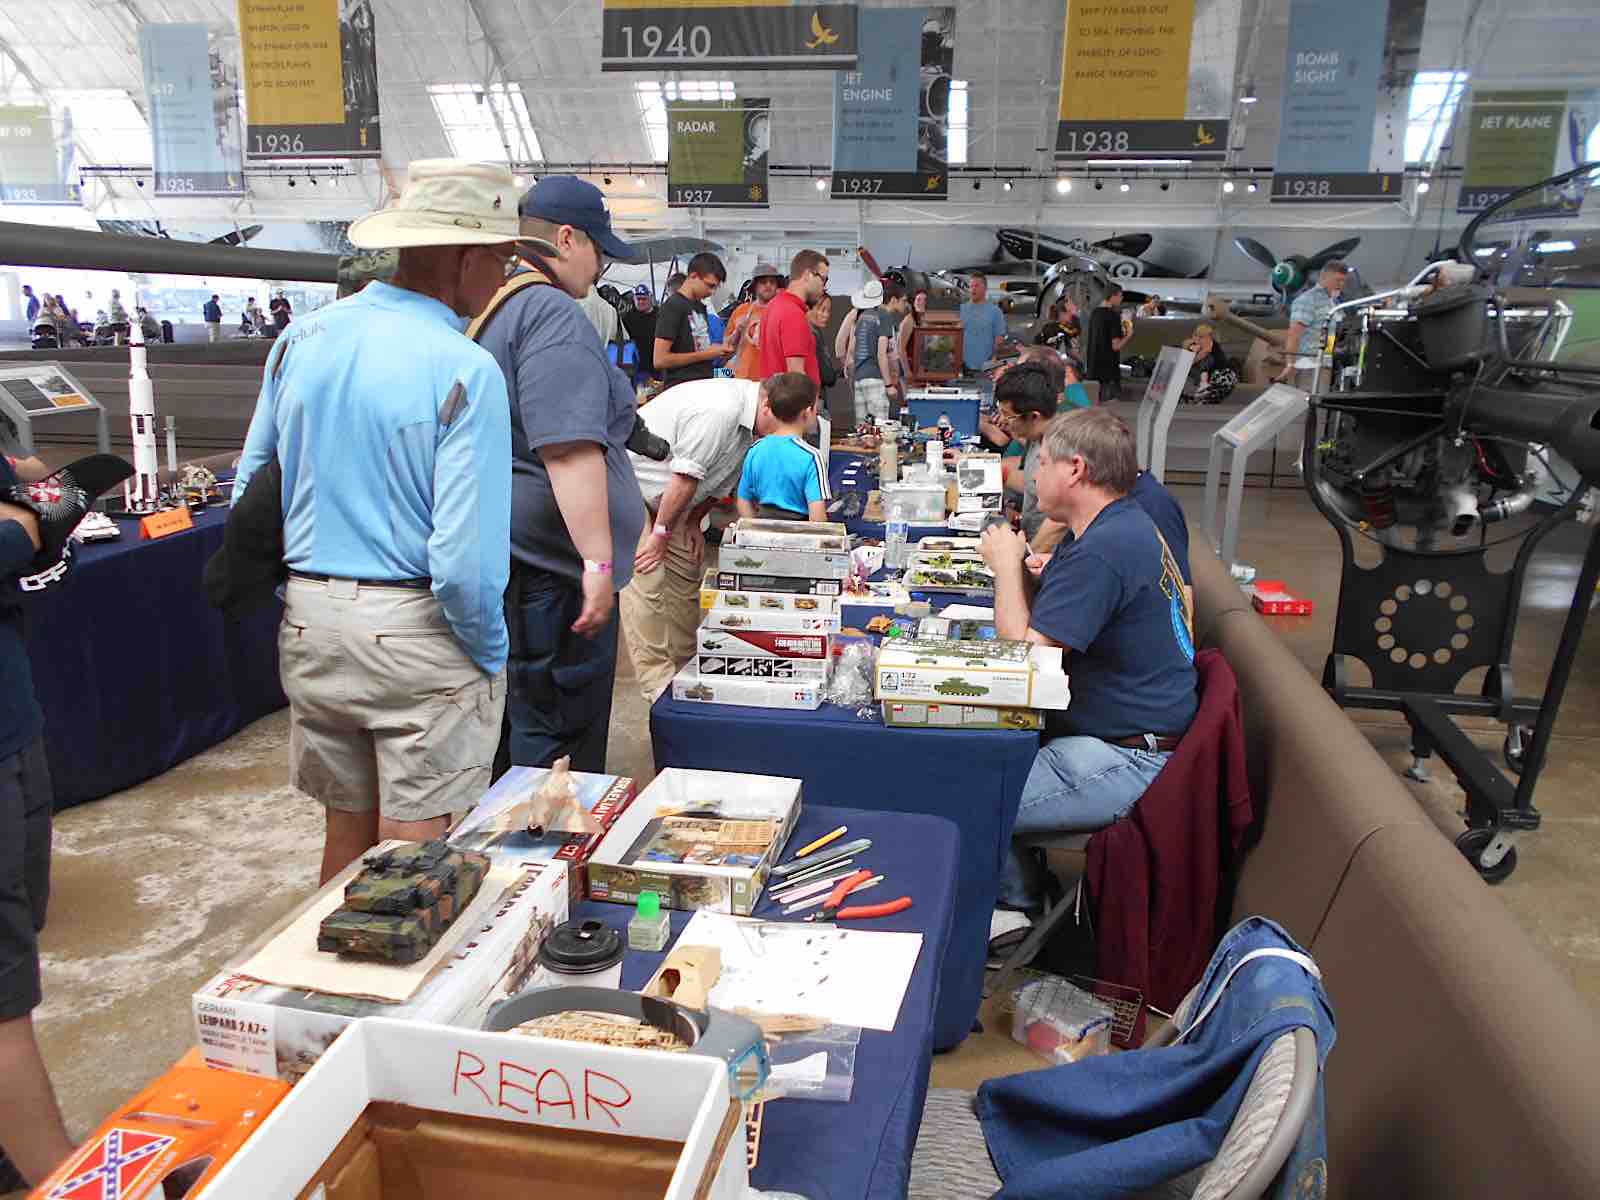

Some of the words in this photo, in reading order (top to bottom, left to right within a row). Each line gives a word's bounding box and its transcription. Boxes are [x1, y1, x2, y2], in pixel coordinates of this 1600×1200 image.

[621, 25, 711, 58] 1940
[1296, 52, 1339, 65] BOMB
[841, 72, 864, 85] JET
[1295, 70, 1337, 83] SIGHT
[842, 88, 894, 102] ENGINE
[677, 121, 716, 133] RADAR
[1480, 115, 1504, 129] JET
[1505, 115, 1553, 129] PLANE
[254, 134, 305, 153] 1936
[1067, 130, 1129, 152] 1938
[160, 177, 194, 192] 1935
[841, 179, 883, 194] 1937
[1283, 180, 1329, 197] 1938
[676, 189, 713, 203] 1937
[1467, 192, 1511, 209] 193
[197, 1013, 238, 1031] LEOPARD
[453, 1050, 632, 1127] REAR
